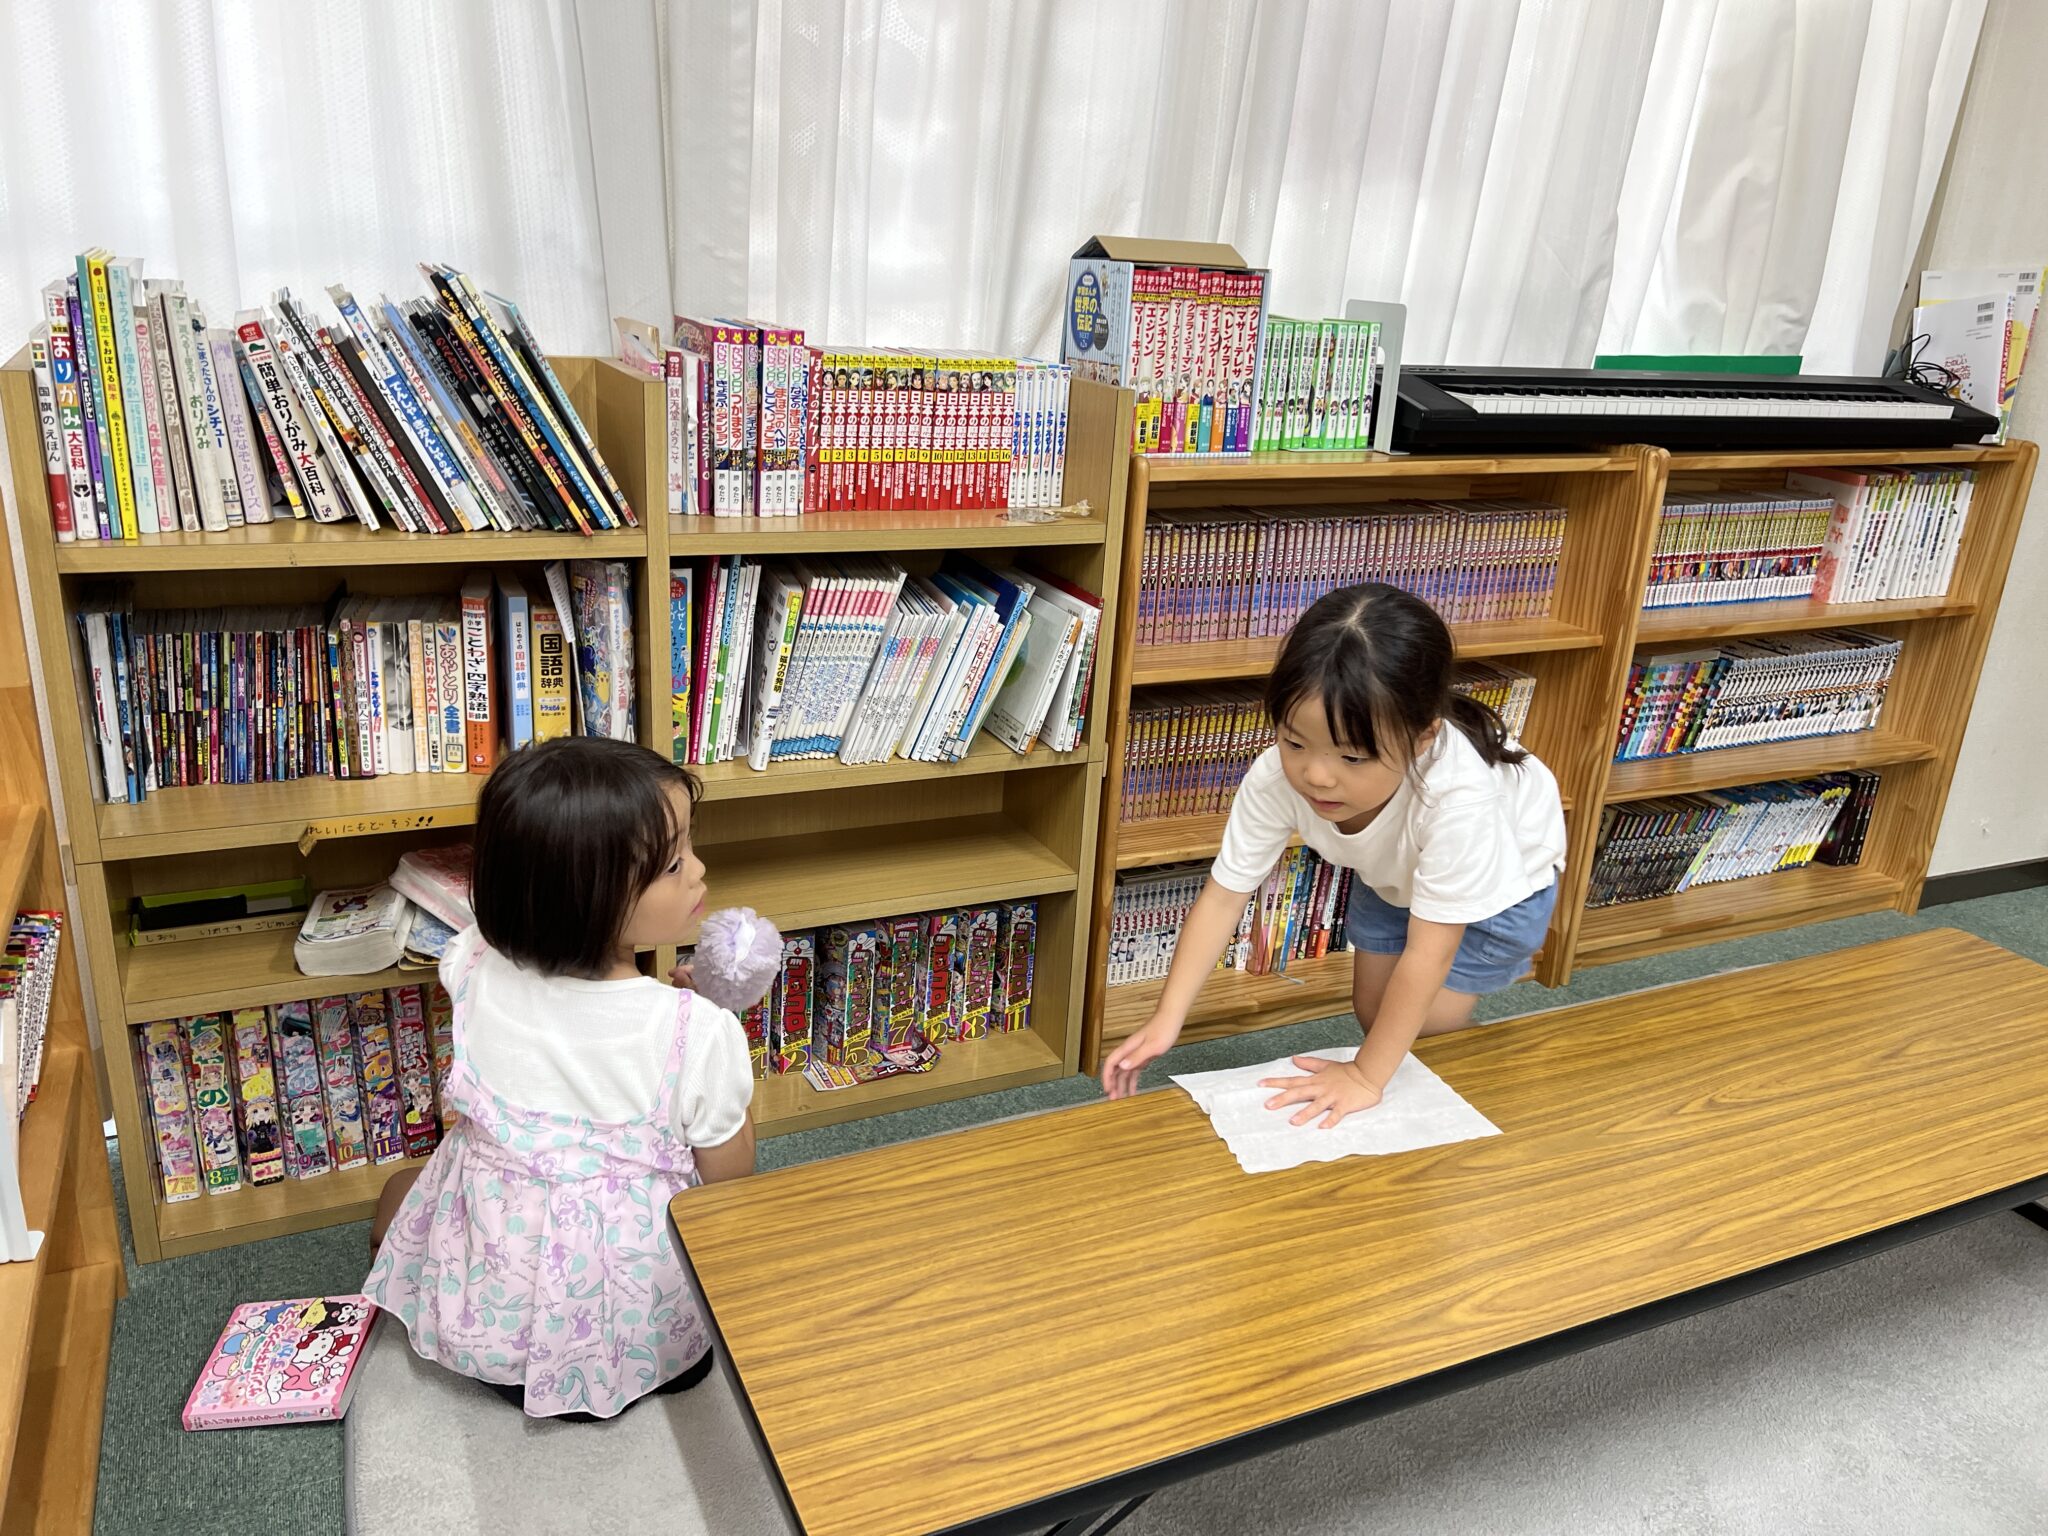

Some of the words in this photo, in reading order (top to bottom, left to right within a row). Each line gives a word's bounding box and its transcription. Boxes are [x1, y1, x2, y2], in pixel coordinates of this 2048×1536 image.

[1075, 296, 1098, 313] 世界の
[1077, 315, 1093, 332] 伝記
[1144, 307, 1156, 356] エジソン
[1132, 306, 1143, 376] マリー・キュリー
[1155, 307, 1168, 379] アンネ・フランク
[1207, 309, 1220, 377] ナイチンゲール
[1222, 311, 1234, 377] ヘレン・ケラー
[1245, 310, 1259, 376] クレオパトラ
[38, 386, 61, 463] 国旗のえほん
[190, 395, 211, 449] おりがみ
[196, 342, 225, 448] こまったさんのシチュー
[257, 361, 326, 497] 簡単おりがみ大百科
[266, 434, 290, 475] ちゃお
[389, 381, 456, 479] でんしゃ・きかんしゃの本
[540, 633, 564, 676] 国語
[540, 677, 564, 689] 辞典
[439, 643, 461, 734] あやとり全書
